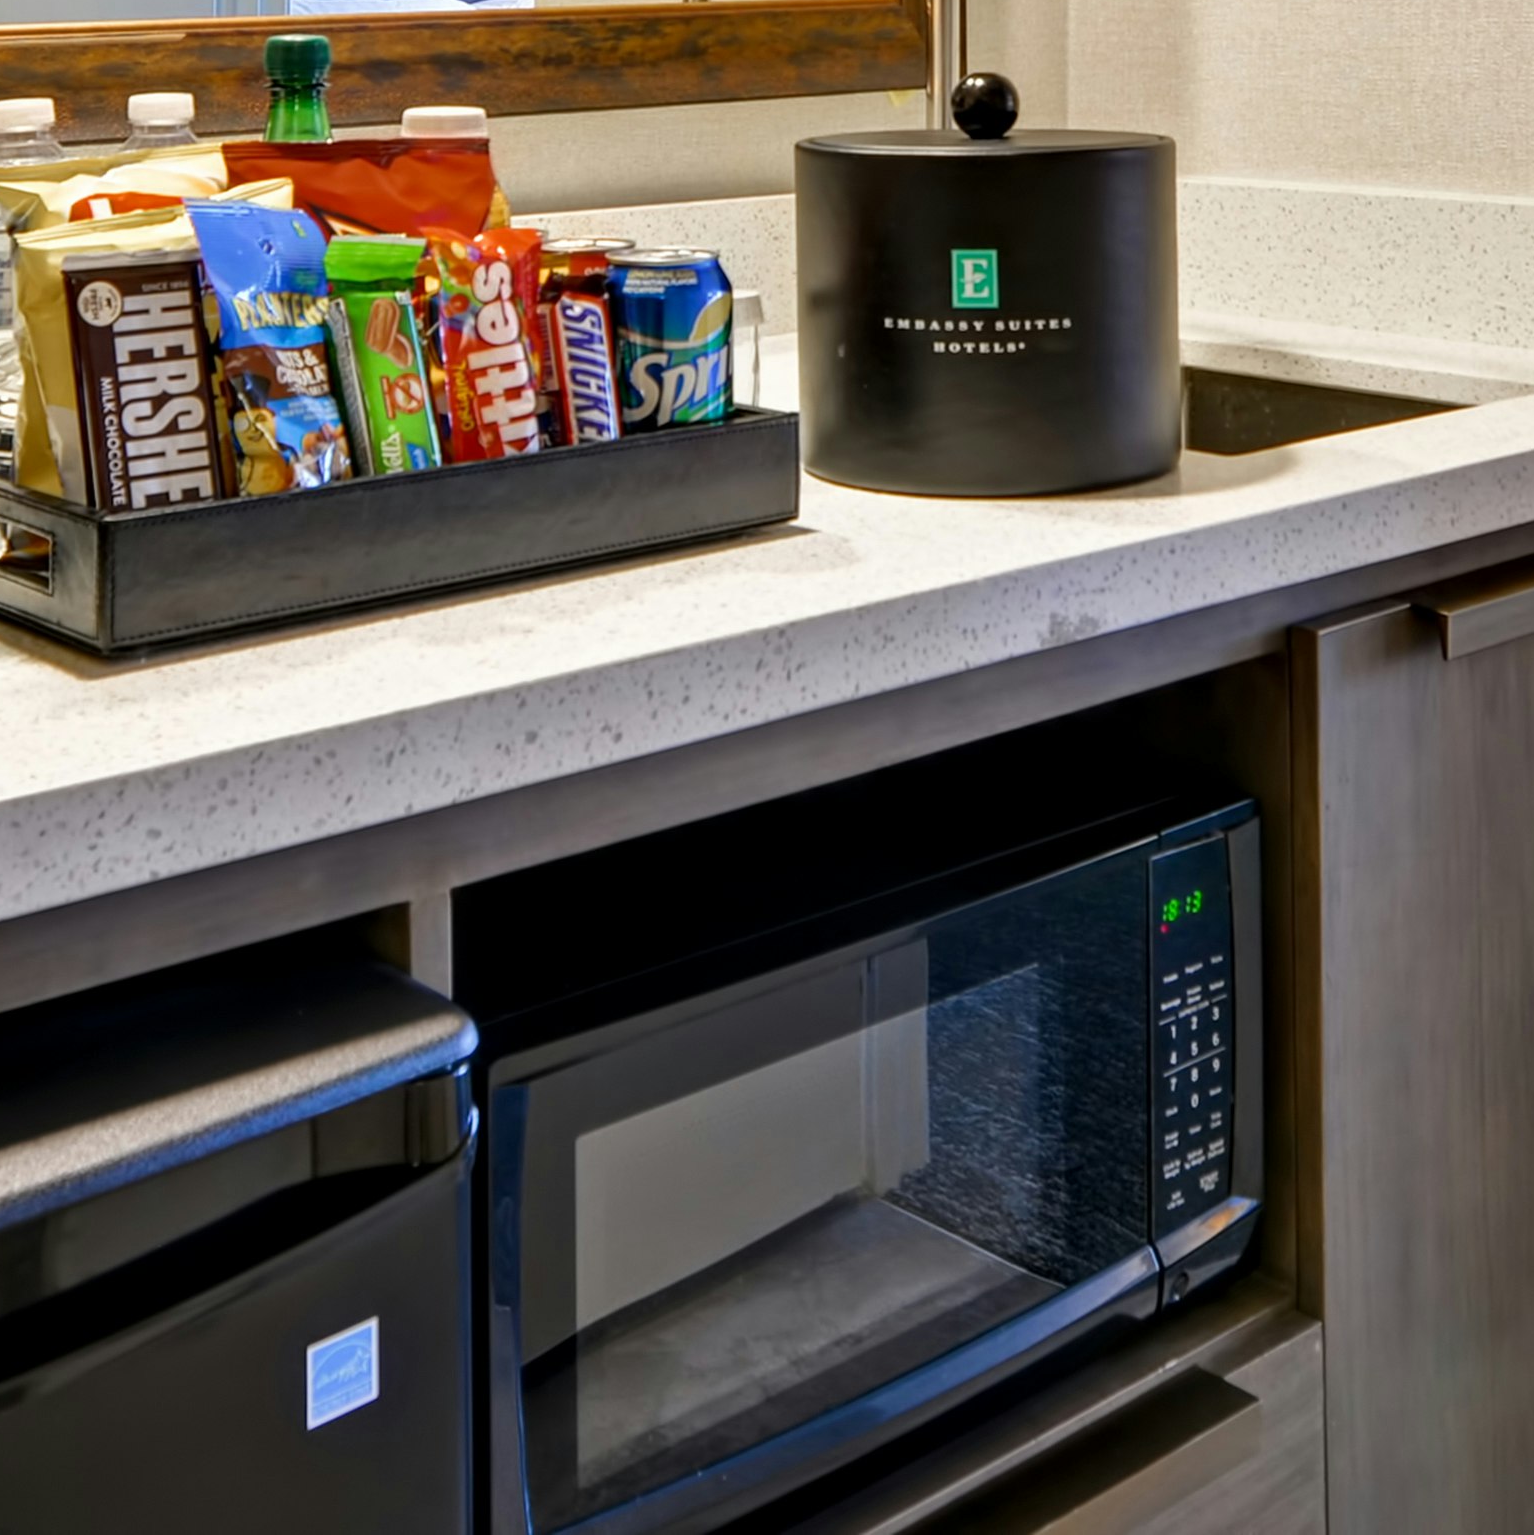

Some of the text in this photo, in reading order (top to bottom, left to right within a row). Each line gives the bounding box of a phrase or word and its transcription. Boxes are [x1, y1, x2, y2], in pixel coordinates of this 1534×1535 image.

[883, 317, 1073, 332] EMBASSY SUITES
[932, 341, 1018, 354] HOTELS
[100, 376, 128, 507] MILK CHOCOLATE
[1171, 1025, 1177, 1039] 1
[1191, 1015, 1198, 1030] 2
[1212, 1006, 1219, 1021] 3
[1170, 1032, 1220, 1065] 4 5 6
[1170, 1057, 1220, 1092] 7 8 9
[1191, 1093, 1199, 1108] 0
